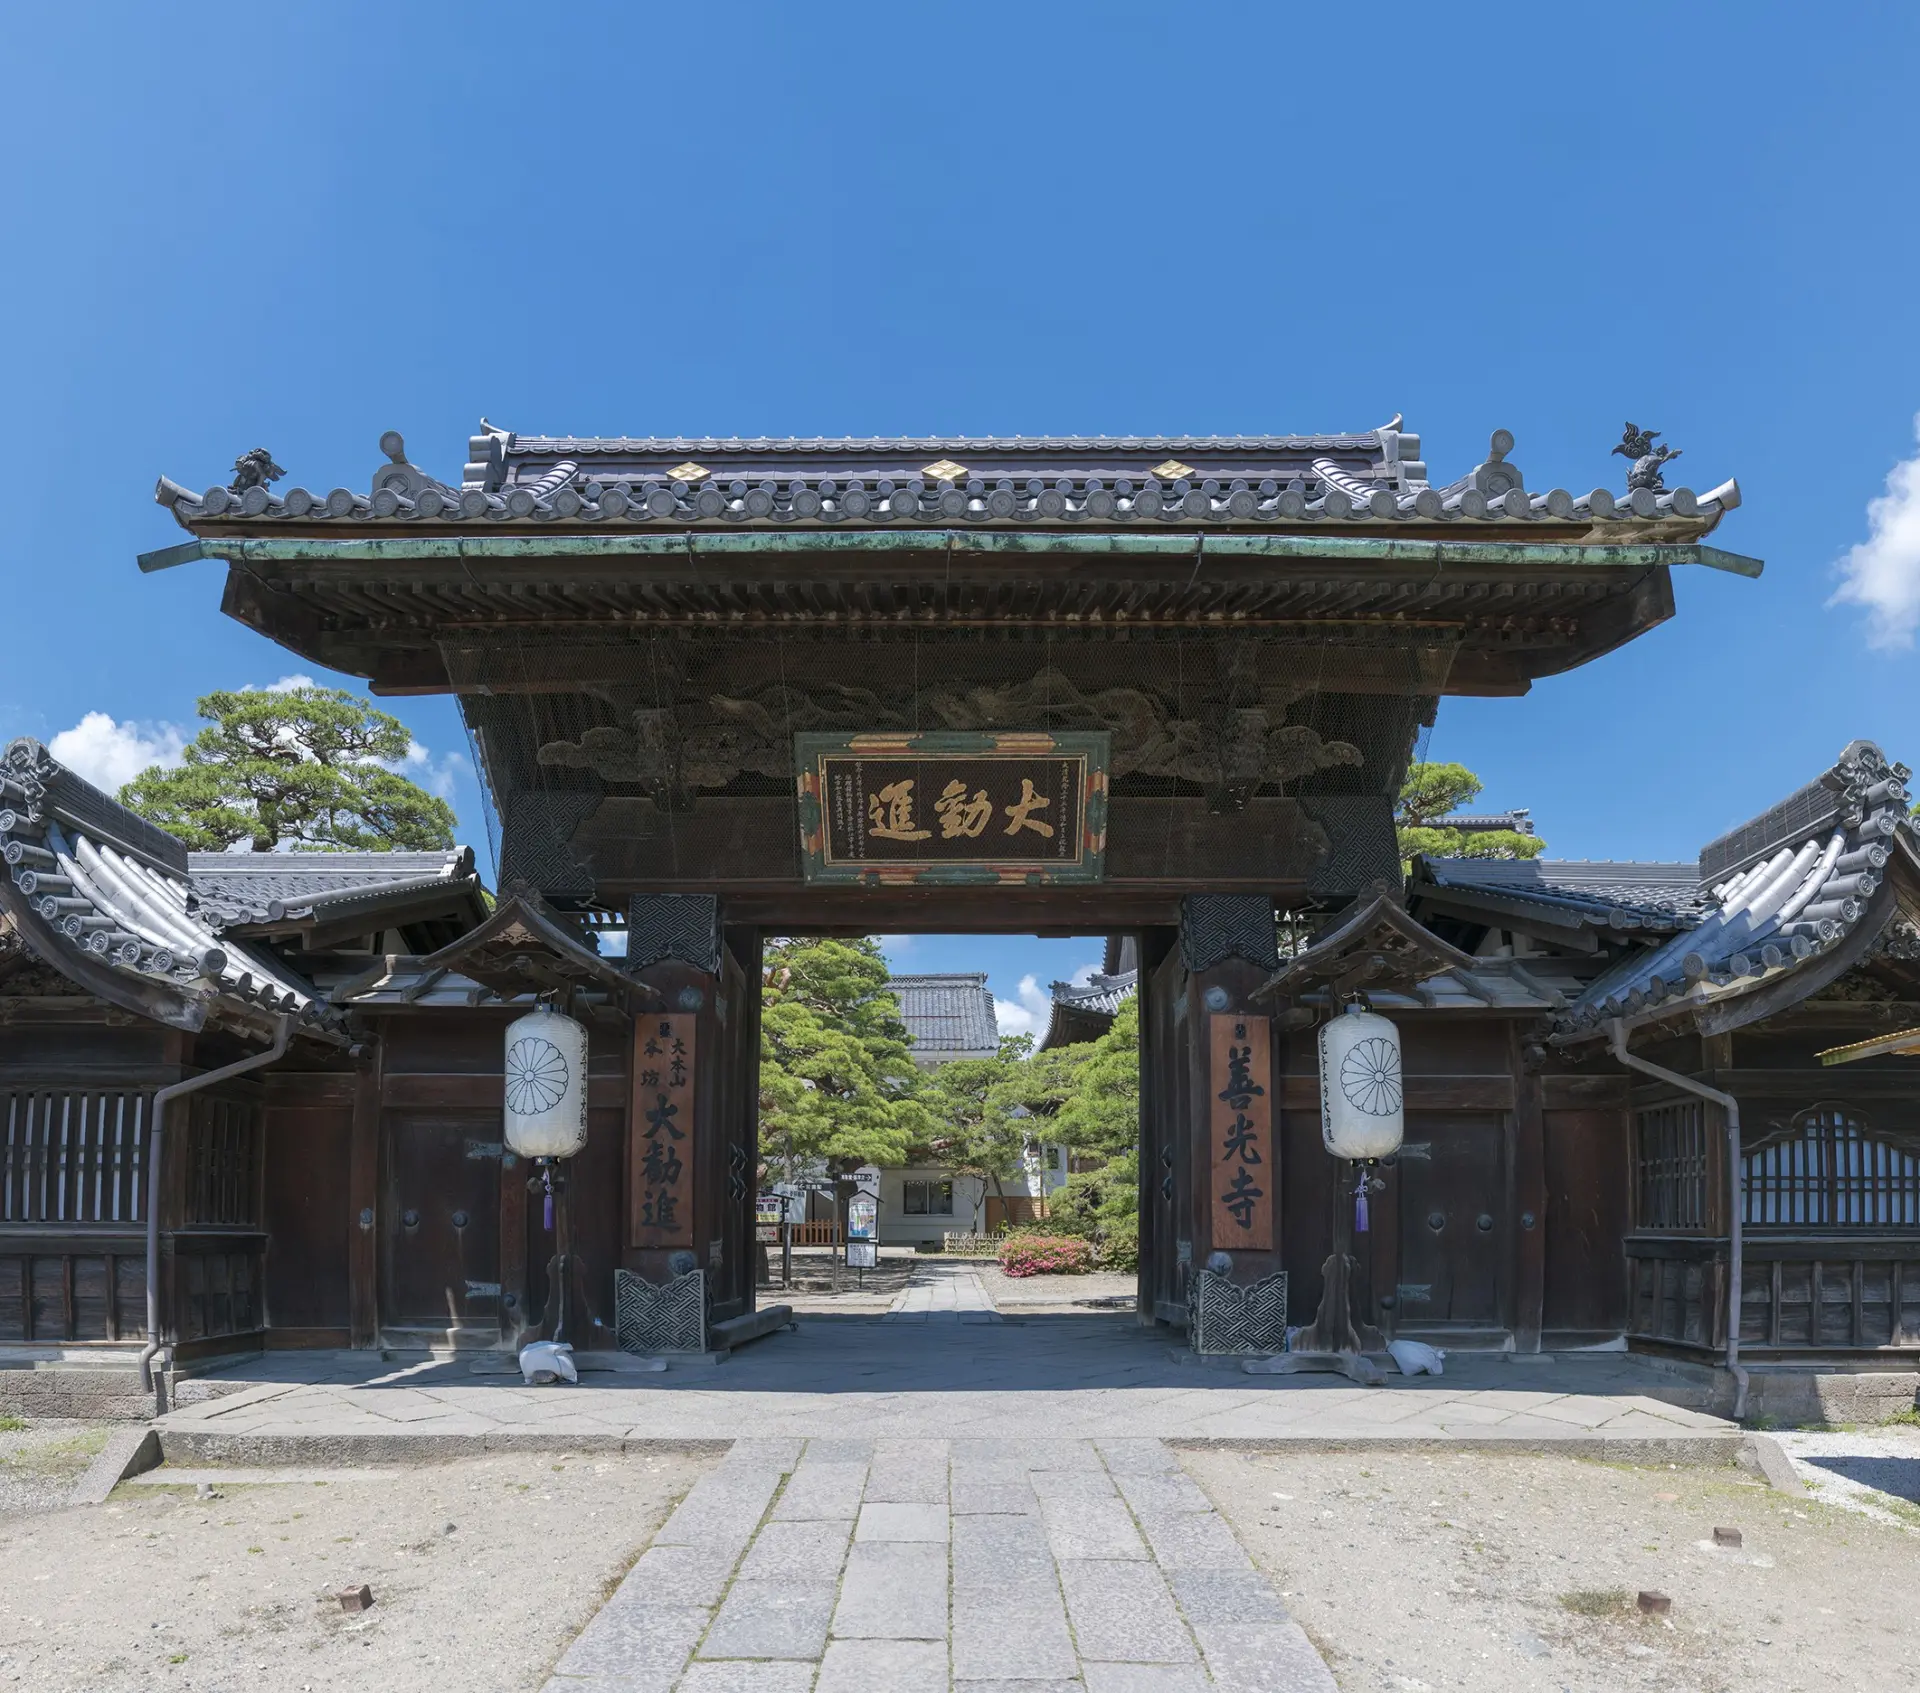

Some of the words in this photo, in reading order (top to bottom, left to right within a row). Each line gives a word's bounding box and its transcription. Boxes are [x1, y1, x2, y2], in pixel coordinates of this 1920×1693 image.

[668, 1037, 688, 1088] 大本山
[1218, 1046, 1265, 1230] 善光寺
